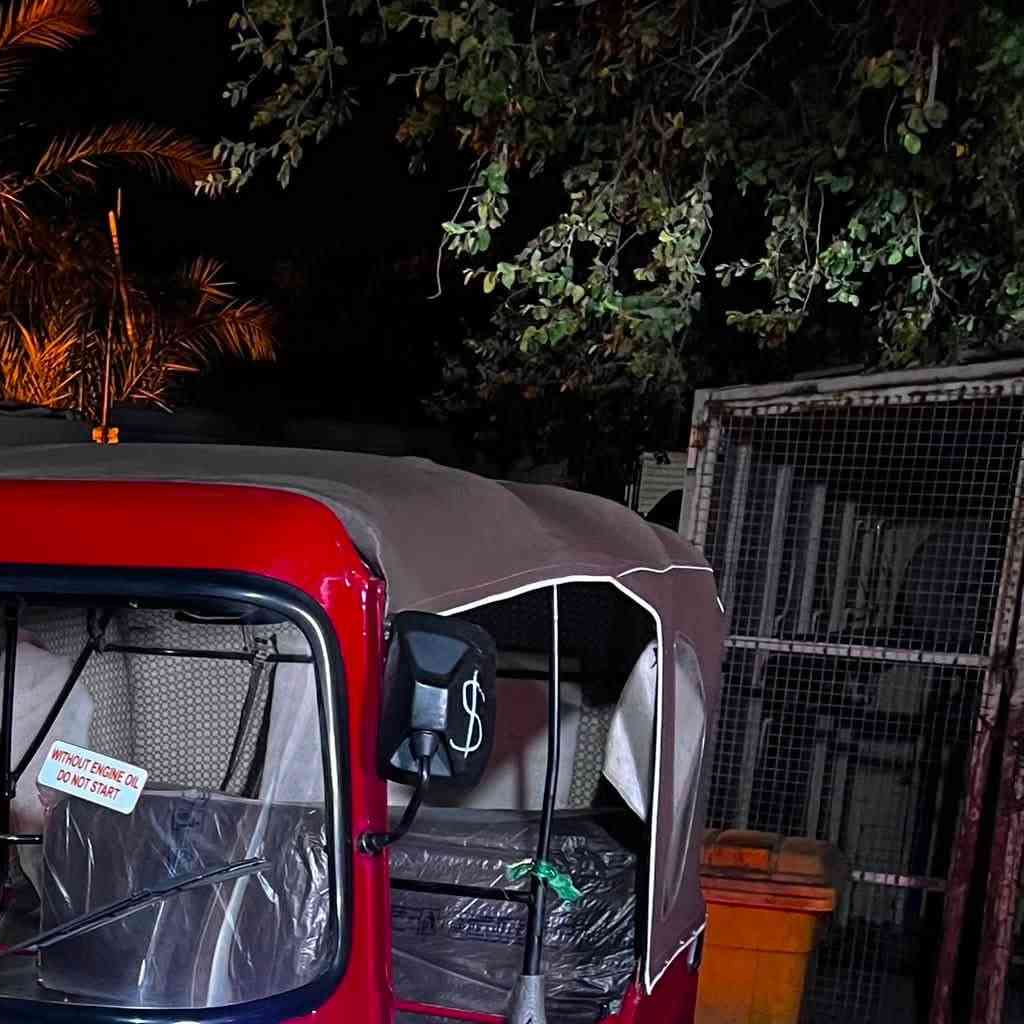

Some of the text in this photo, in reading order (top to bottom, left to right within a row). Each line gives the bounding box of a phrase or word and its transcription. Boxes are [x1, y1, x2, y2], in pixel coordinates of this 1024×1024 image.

[51, 749, 140, 789] WITHOUT ENGINE OIL
[56, 769, 120, 801] DO NOT START
